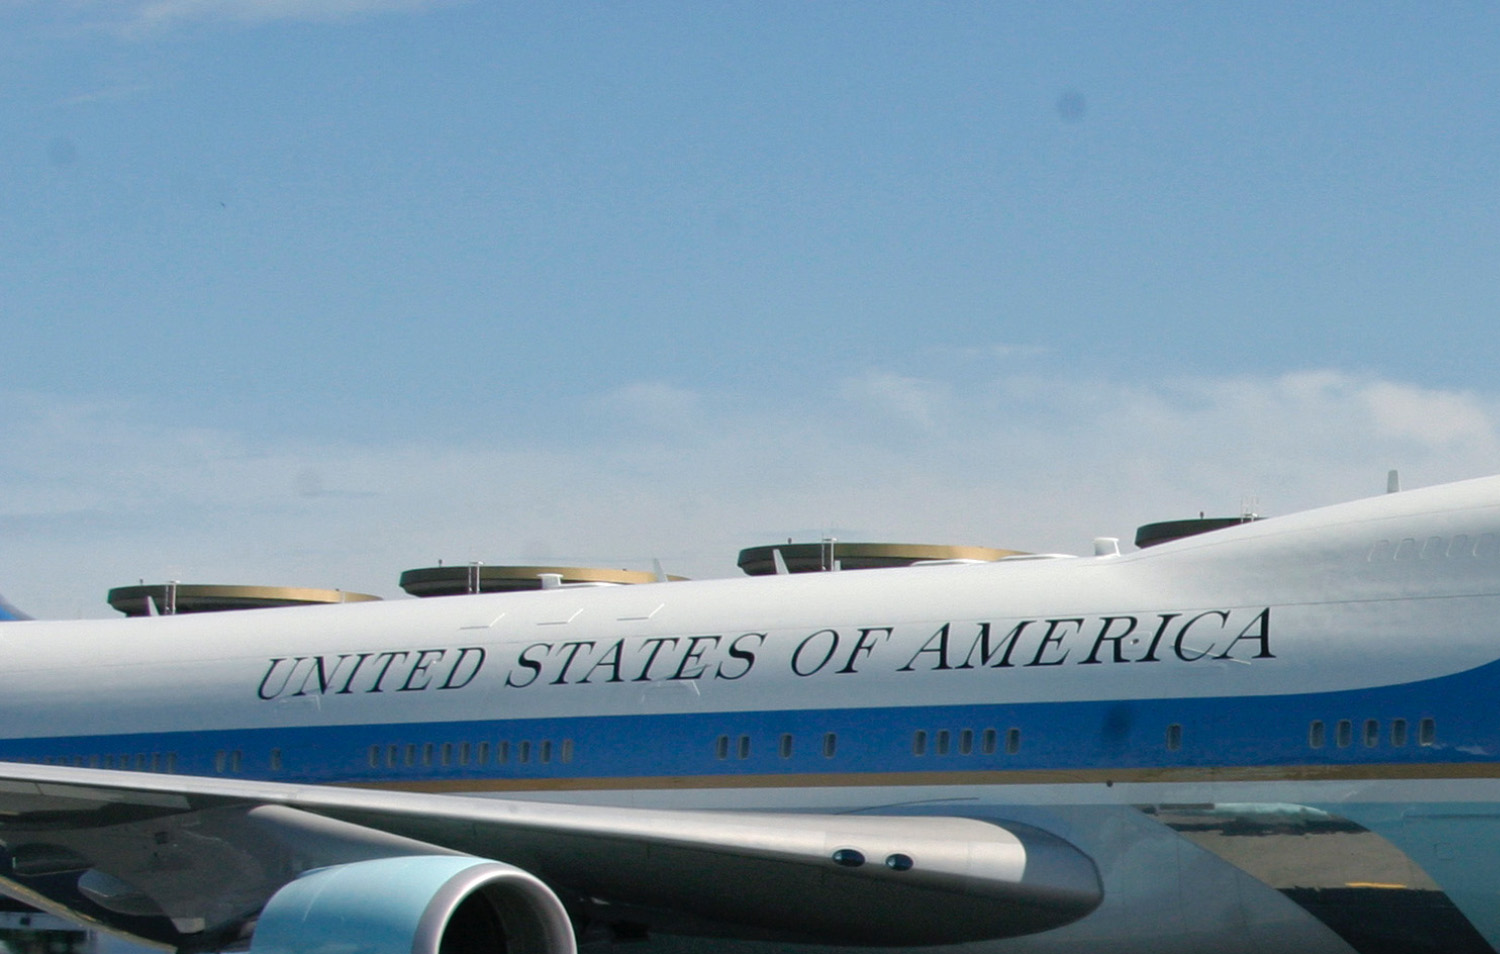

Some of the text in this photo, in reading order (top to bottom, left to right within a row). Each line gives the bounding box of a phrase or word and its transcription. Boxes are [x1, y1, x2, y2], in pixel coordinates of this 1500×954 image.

[257, 607, 1279, 701] UNITED STATES OF AMERICA
